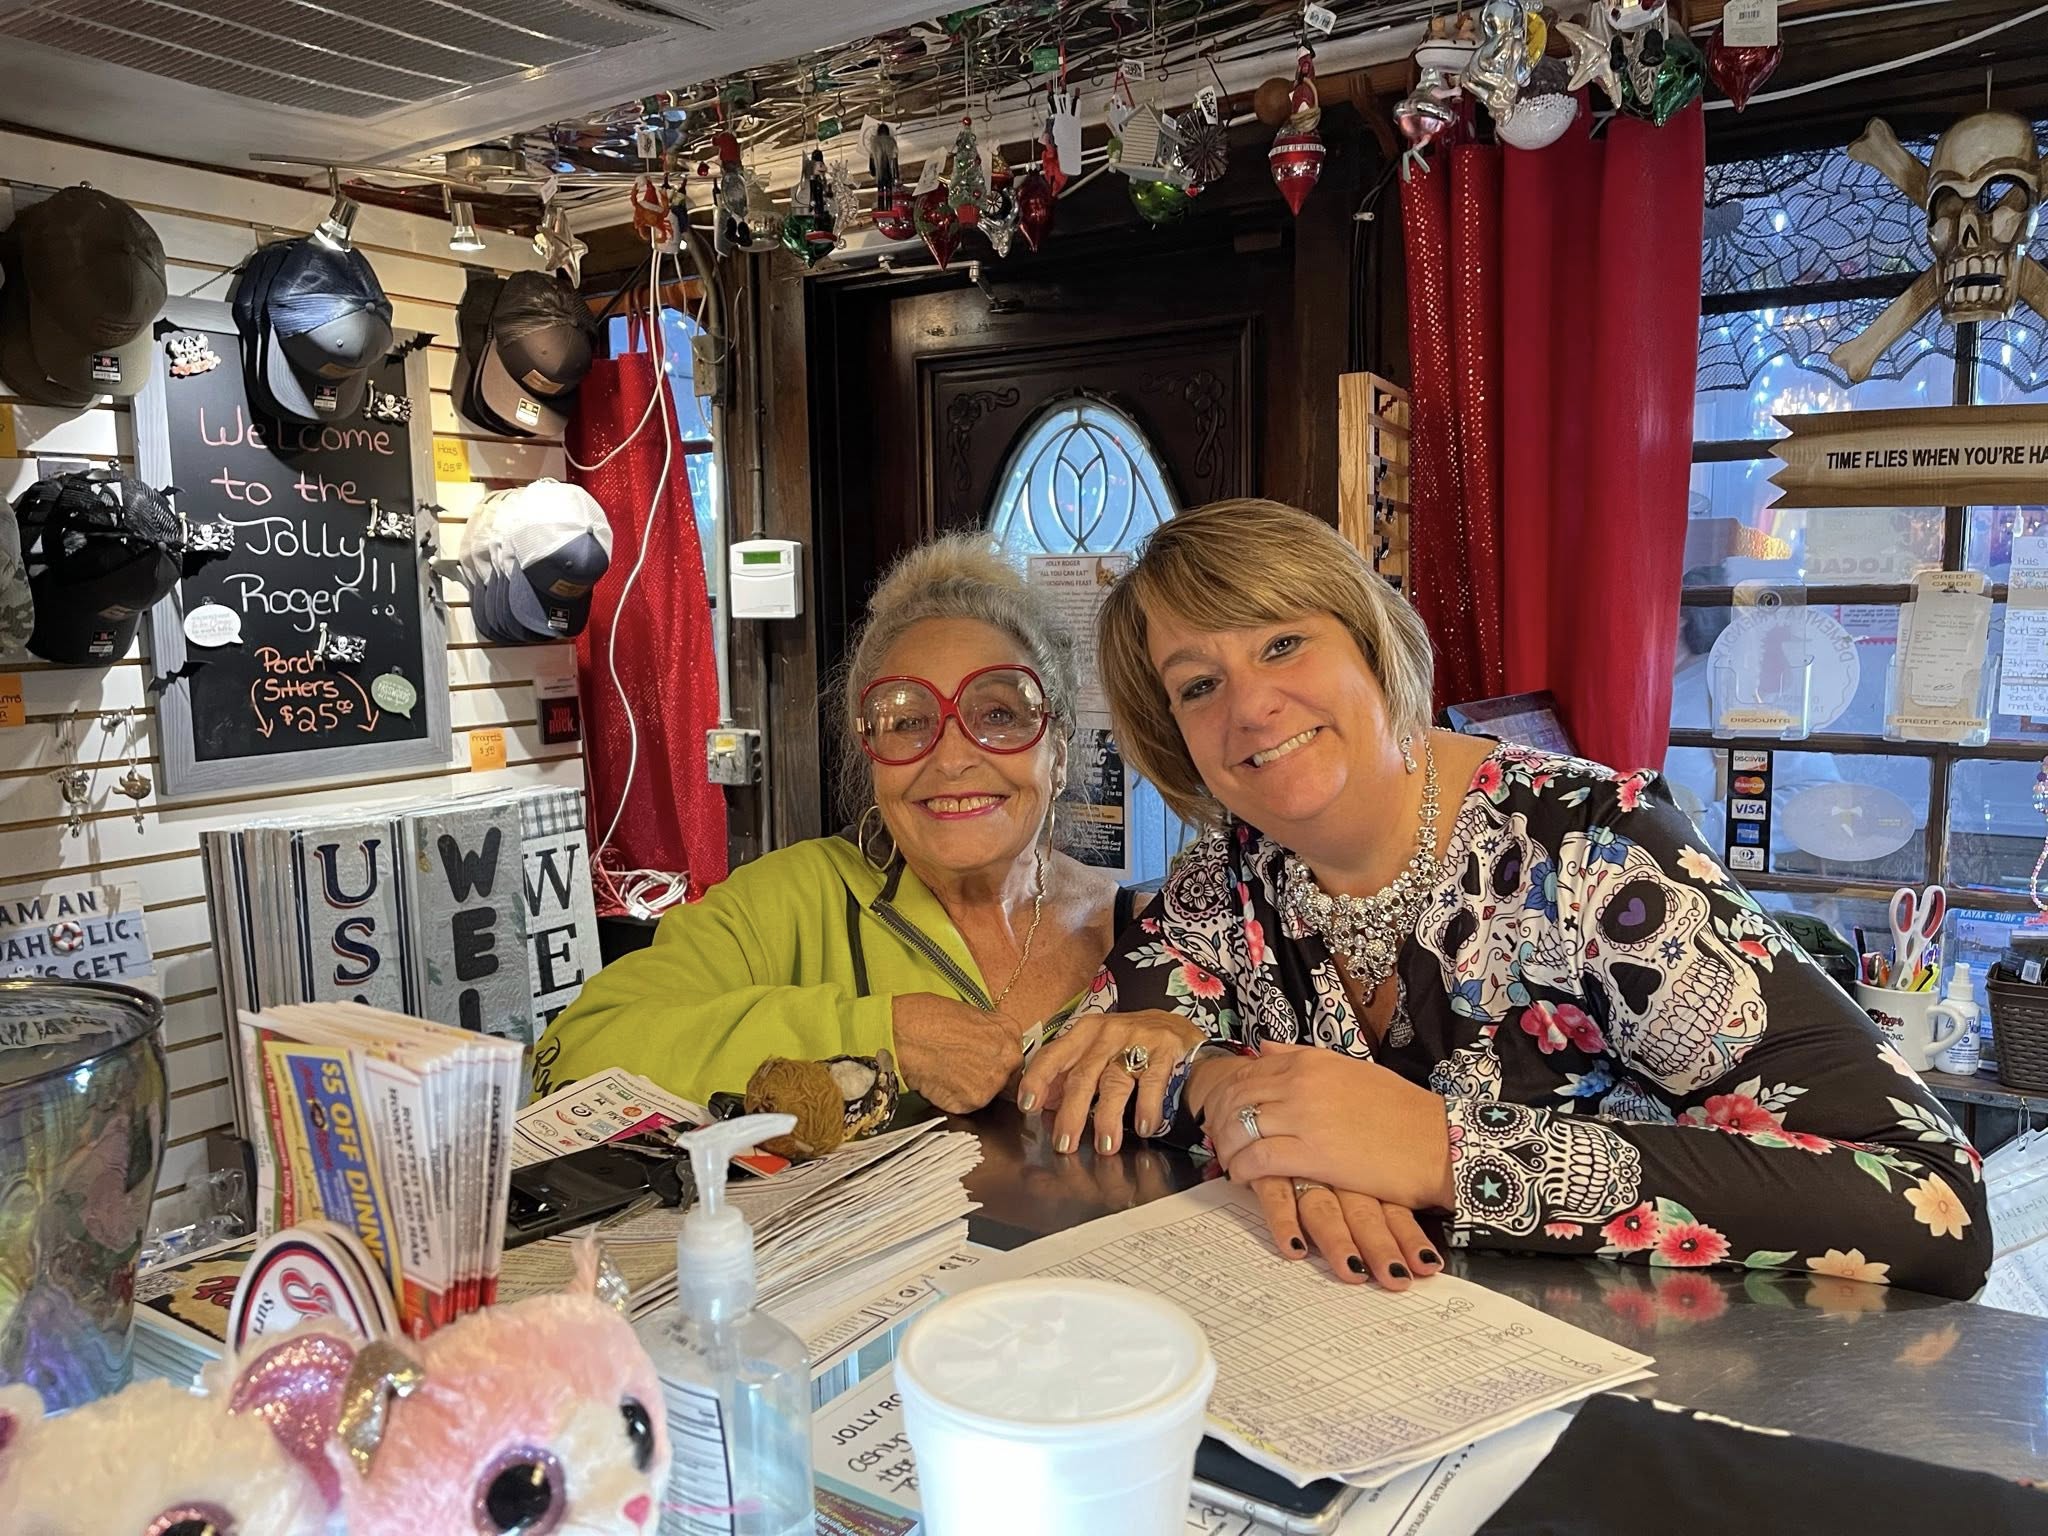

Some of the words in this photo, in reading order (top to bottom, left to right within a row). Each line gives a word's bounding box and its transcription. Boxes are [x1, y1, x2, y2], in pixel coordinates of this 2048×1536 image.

[200, 404, 395, 455] Welcome
[1826, 451, 1862, 469] TIME
[1865, 450, 1908, 468] FLIES
[1912, 448, 1961, 467] WHEN
[1963, 446, 2025, 466] YOU'RE
[211, 466, 273, 506] to
[293, 470, 367, 505] the
[217, 512, 367, 587] Jolly
[222, 573, 364, 633] Roger
[254, 646, 327, 674] Porch
[1896, 718, 1940, 726] CREDIT
[1942, 719, 1983, 727] CARDS
[1734, 755, 1766, 763] DISCOVER
[1735, 804, 1765, 815] VISA
[58, 890, 98, 917] AN
[1960, 910, 1988, 921] KAYAK
[1993, 913, 2016, 923] SURF
[321, 1061, 345, 1096] $5
[330, 1103, 361, 1163] OFF
[387, 1087, 405, 1151] HONEY
[397, 1153, 414, 1222] GLAZED
[407, 1224, 421, 1267] HAM
[401, 1106, 420, 1187] ROASTED
[412, 1192, 433, 1259] TURKEY
[831, 1408, 883, 1446] JOLLY
[1430, 1470, 1456, 1502] ENTRANCE
